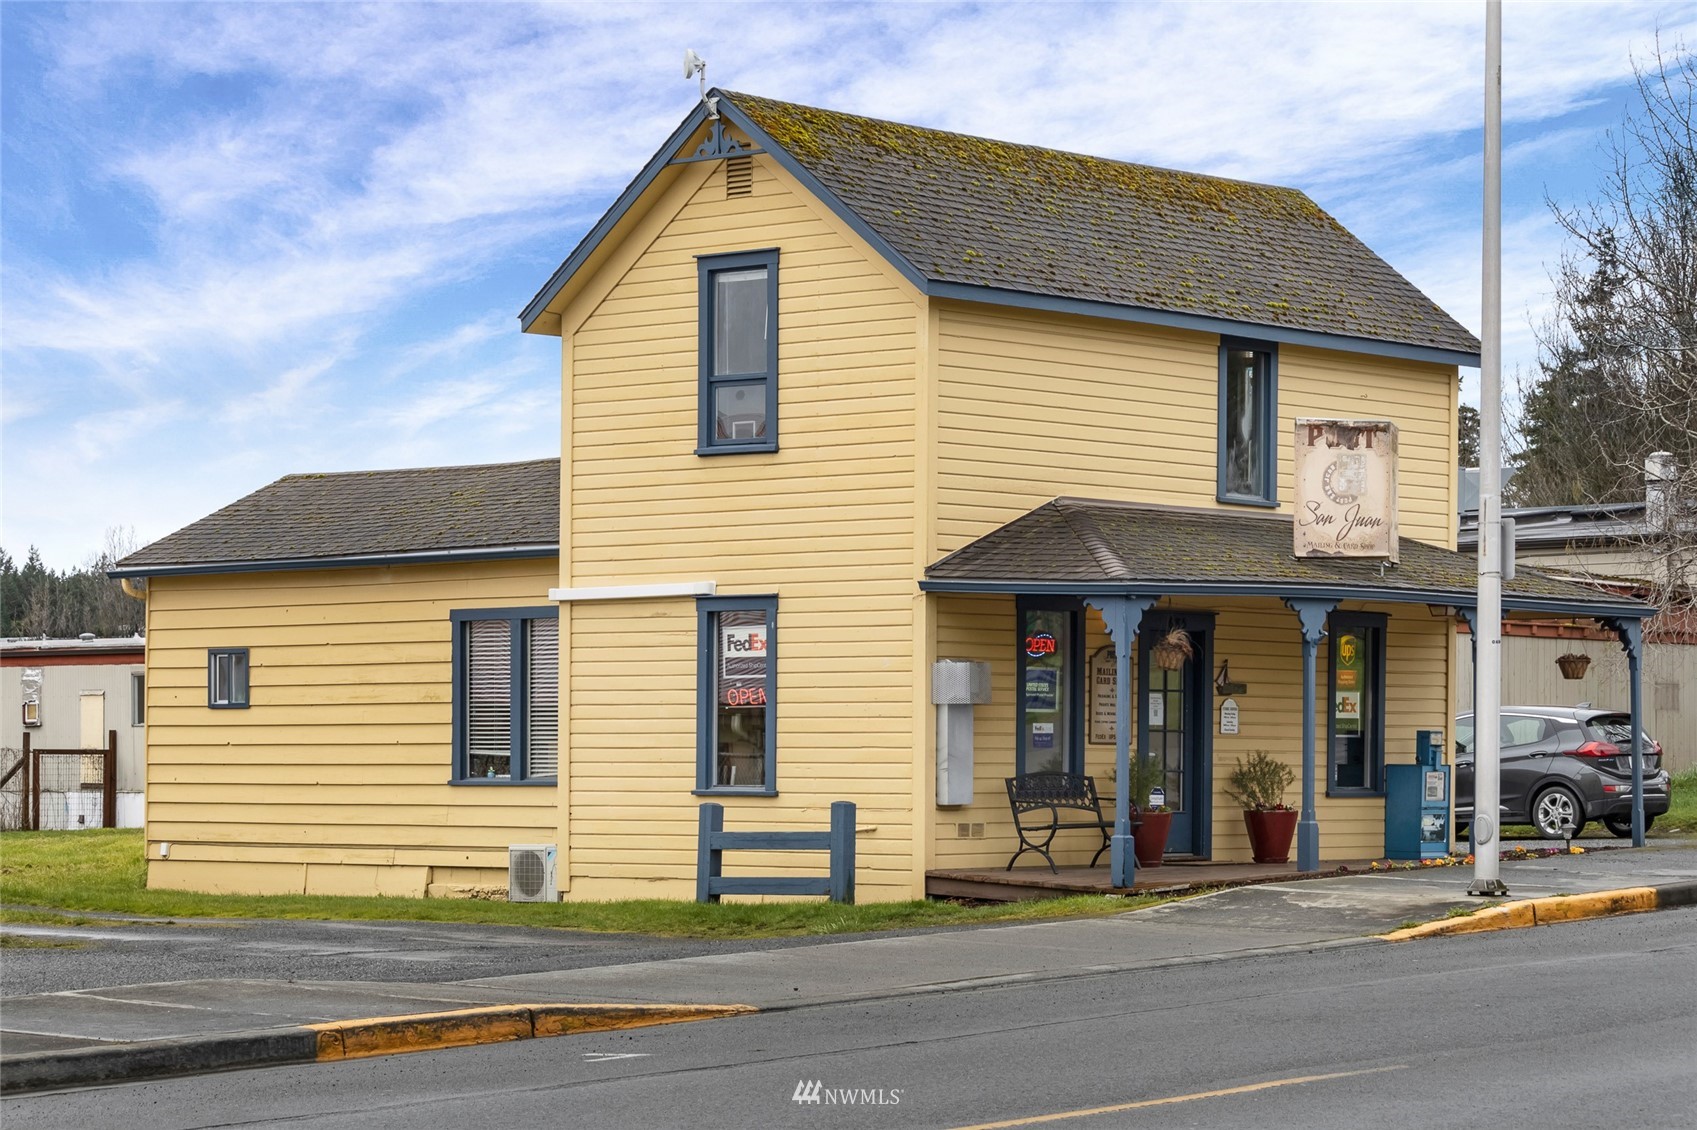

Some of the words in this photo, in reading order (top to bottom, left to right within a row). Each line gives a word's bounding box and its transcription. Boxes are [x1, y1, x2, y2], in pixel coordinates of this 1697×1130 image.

[1307, 425, 1377, 450] PT
[1299, 500, 1337, 526] San
[1336, 503, 1384, 541] Juan
[727, 633, 767, 652] FedEx
[1026, 637, 1055, 653] OPEN
[1342, 645, 1355, 661] ups
